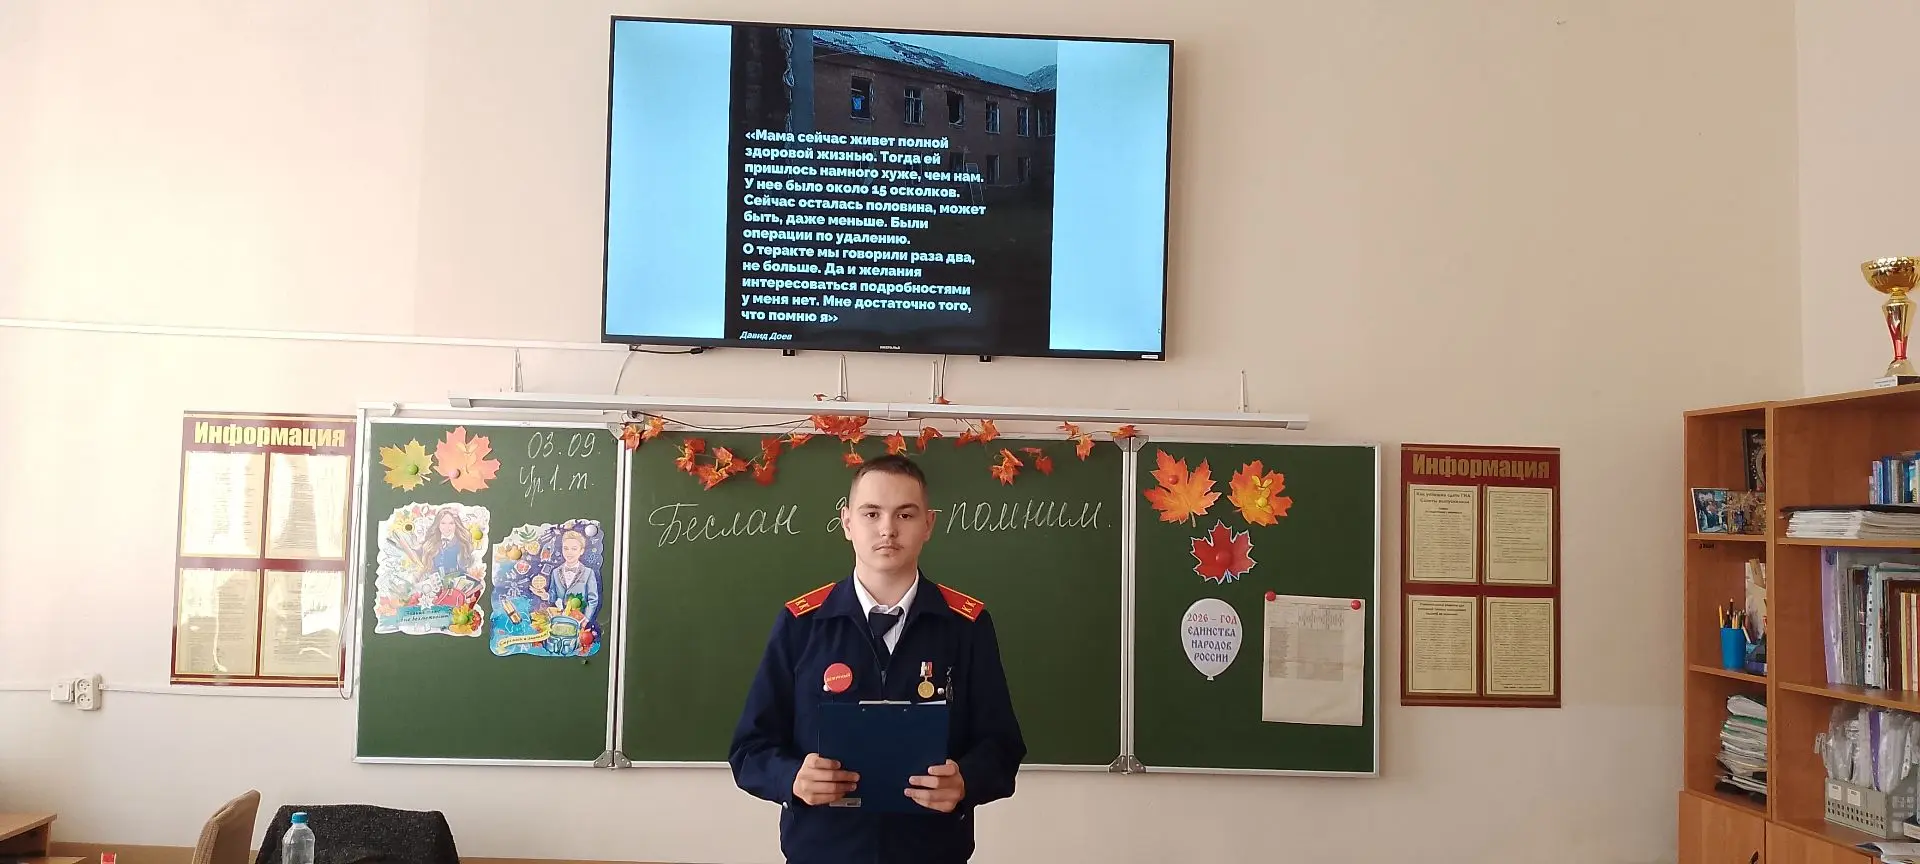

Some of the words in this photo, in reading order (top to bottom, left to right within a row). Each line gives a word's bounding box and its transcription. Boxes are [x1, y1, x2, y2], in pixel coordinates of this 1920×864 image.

[797, 132, 847, 144] сейчас
[849, 135, 895, 146] живет
[897, 136, 948, 148] полной
[744, 147, 813, 160] здоровой
[816, 150, 877, 162] жизнью.
[879, 150, 922, 165] Тогда
[923, 152, 941, 164] ей
[744, 163, 817, 176] пришлось
[819, 166, 879, 178] намного
[880, 169, 921, 182] хуже,
[924, 171, 951, 181] чем
[953, 172, 984, 183] нам.
[744, 177, 754, 189] У
[756, 180, 783, 190] нее
[785, 179, 823, 192] было
[825, 183, 869, 194] около
[871, 184, 887, 197] 15
[889, 186, 960, 198] осколков.
[743, 193, 796, 207] Сейчас
[798, 198, 863, 210] осталась
[865, 201, 936, 215] половина,
[939, 204, 986, 215] может
[743, 210, 783, 225] быть,
[785, 214, 825, 225] даже
[827, 216, 887, 227] меньше.
[890, 216, 928, 229] Были
[742, 229, 813, 242] операции
[815, 231, 833, 241] по
[835, 232, 910, 245] удалению.
[742, 242, 754, 254] О
[756, 245, 814, 258] теракте
[817, 248, 839, 258] мы
[842, 249, 908, 262] говорили
[910, 251, 943, 264] раза
[945, 253, 975, 265] два,
[742, 261, 760, 271] не
[762, 259, 821, 273] больше.
[823, 262, 844, 276] Да
[847, 265, 856, 274] и
[858, 266, 922, 277] желания
[742, 277, 857, 291] интересоваться
[860, 281, 970, 295] подробностями
[741, 294, 750, 306] у
[752, 294, 789, 305] меня
[792, 296, 819, 306] нет.
[822, 294, 852, 307] Мне
[854, 298, 936, 310] достаточно
[937, 301, 971, 314] того,
[741, 310, 765, 320] что
[768, 311, 817, 321] помню
[739, 330, 768, 340] Давид
[194, 421, 345, 449] Информация
[1412, 454, 1550, 480] Информация
[648, 502, 800, 548] Беслан
[1187, 613, 1209, 623] 2026
[1220, 614, 1238, 625] ГОД
[1191, 639, 1232, 651] НАРОДОВ
[1194, 652, 1229, 663] РОССИИ
